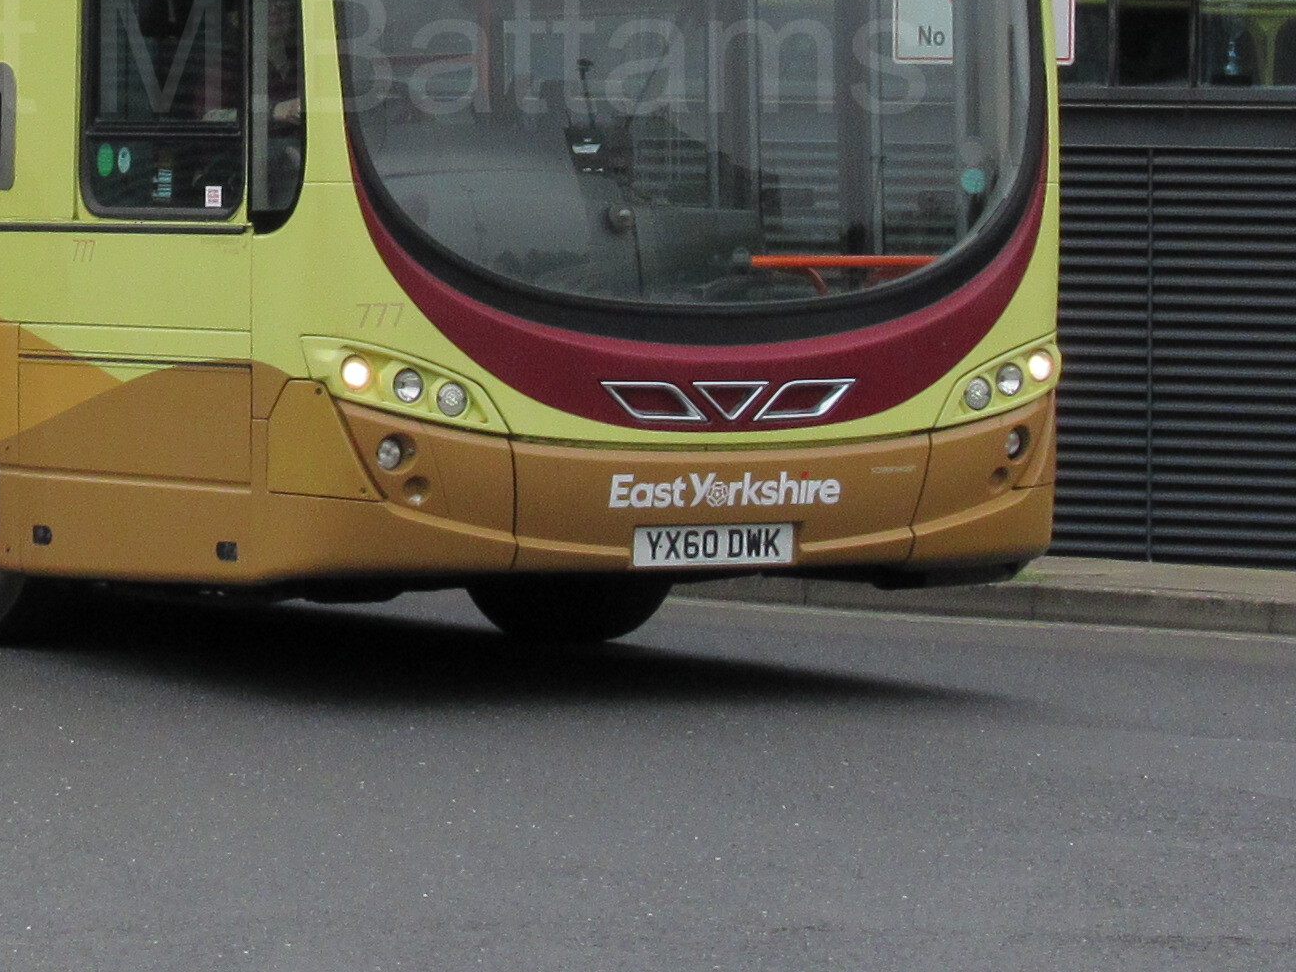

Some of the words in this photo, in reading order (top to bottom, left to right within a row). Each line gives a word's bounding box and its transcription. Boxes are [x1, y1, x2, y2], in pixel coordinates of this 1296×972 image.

[918, 25, 945, 46] No
[72, 239, 96, 262] 777
[355, 302, 405, 329] 777
[608, 473, 687, 508] East
[688, 470, 841, 508] Yorkshire
[646, 529, 719, 561] YX60
[727, 527, 781, 559] DWK
